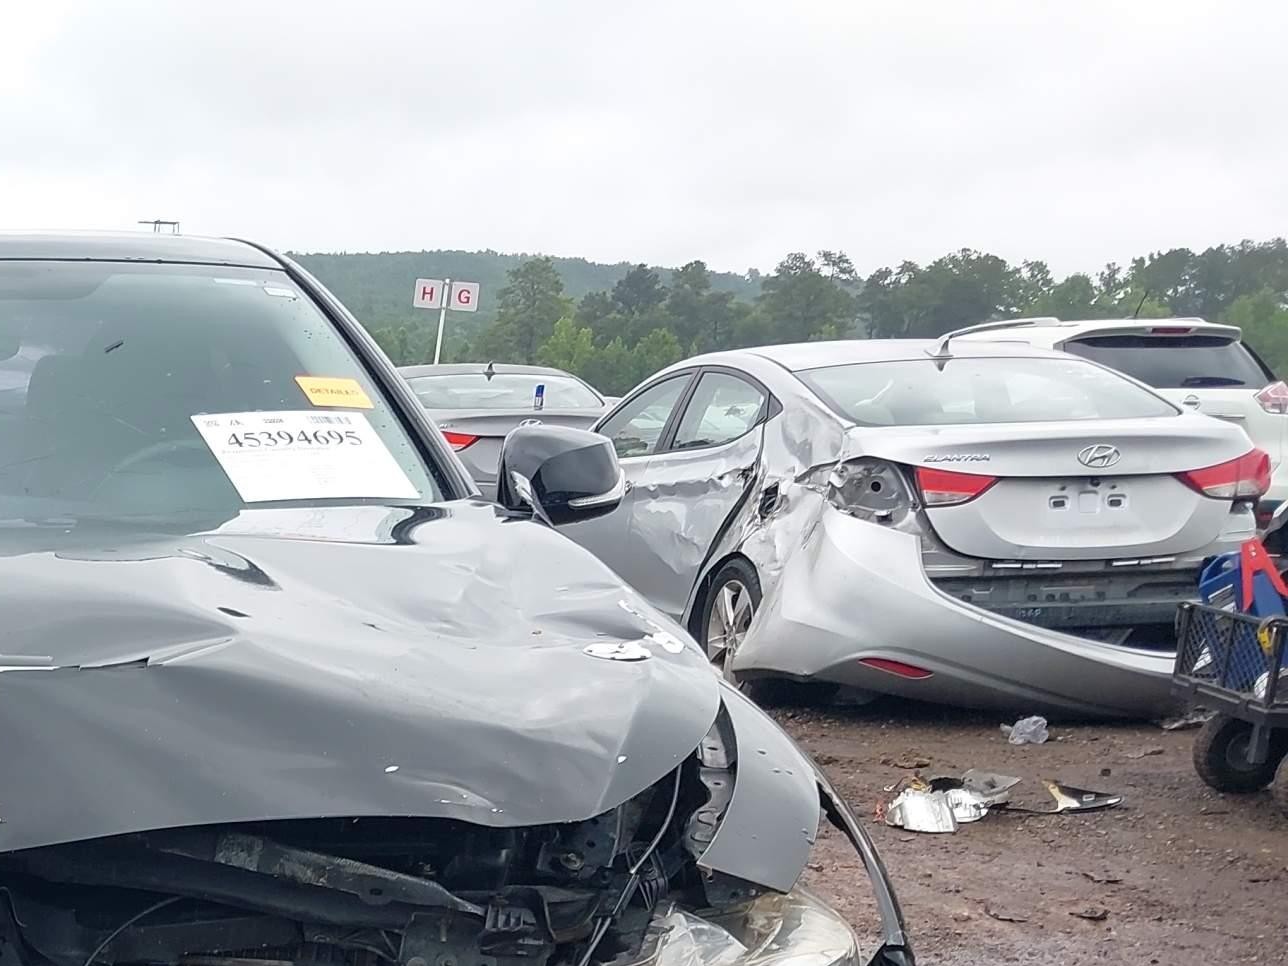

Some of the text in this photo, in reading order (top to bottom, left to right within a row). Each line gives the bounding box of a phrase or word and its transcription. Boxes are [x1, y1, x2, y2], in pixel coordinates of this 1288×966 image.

[421, 286, 434, 301] H
[457, 288, 471, 304] G
[228, 429, 363, 448] 45394695
[923, 453, 991, 463] ELANTRA
